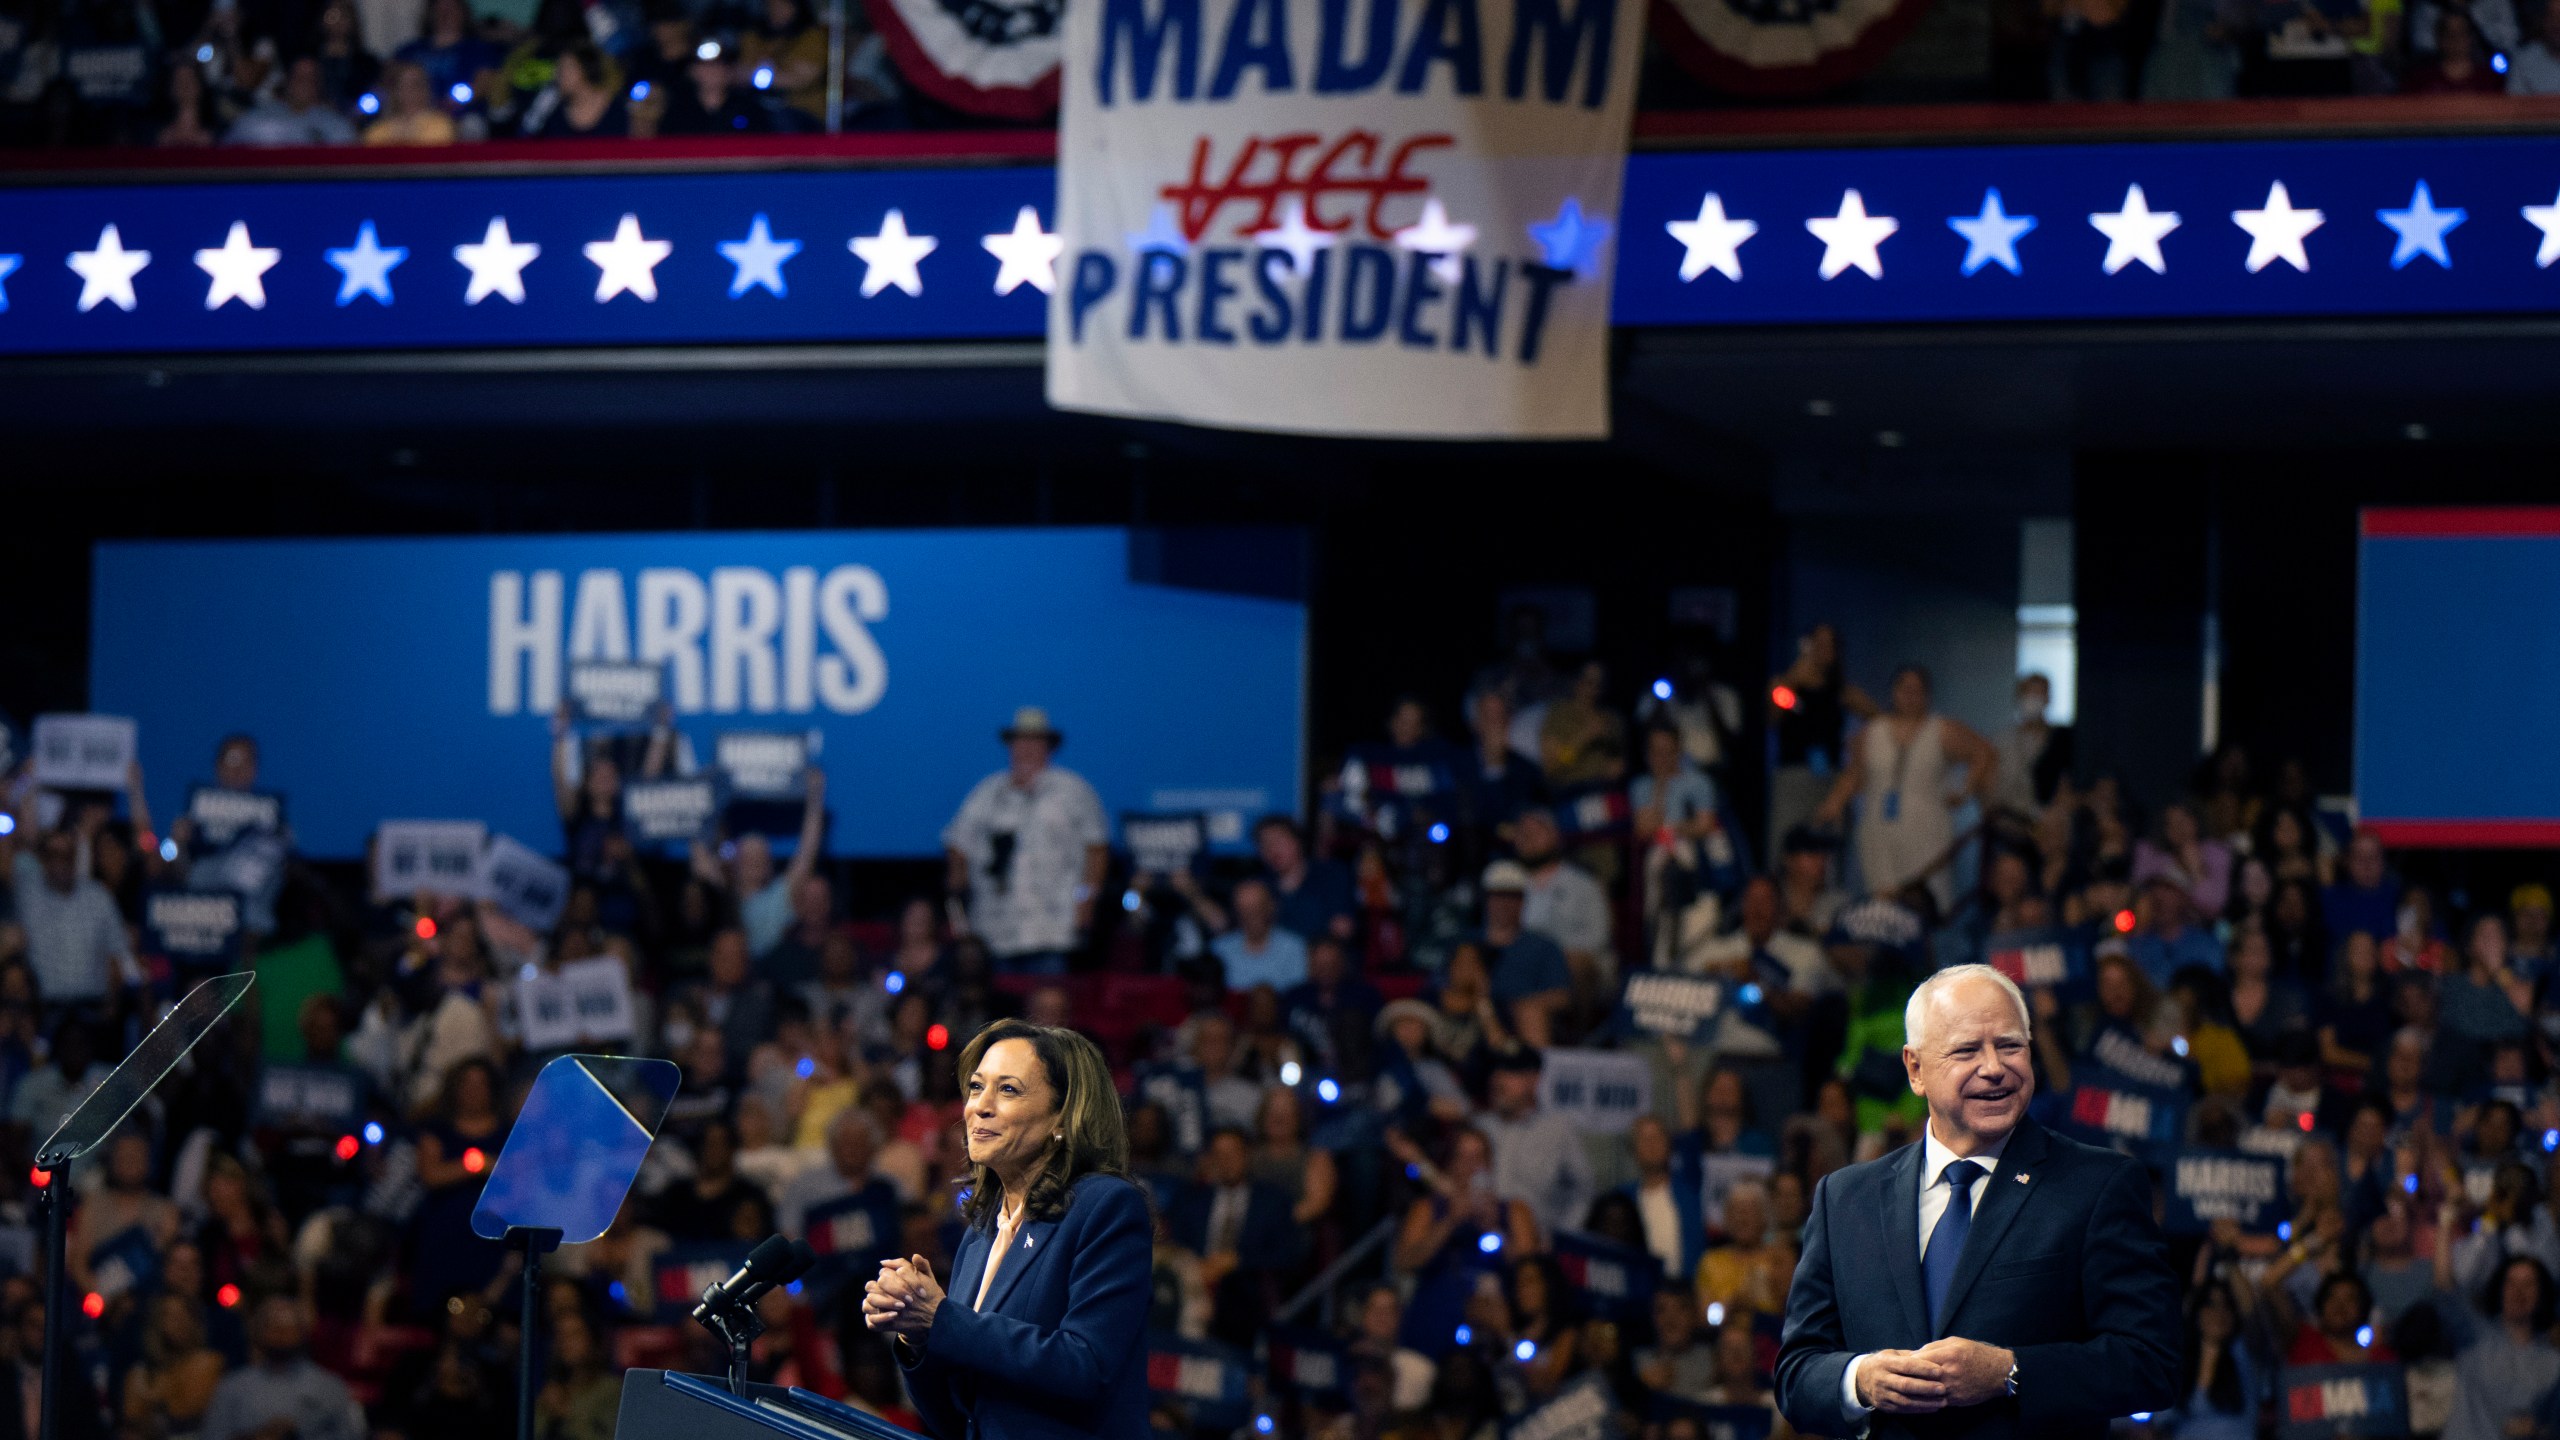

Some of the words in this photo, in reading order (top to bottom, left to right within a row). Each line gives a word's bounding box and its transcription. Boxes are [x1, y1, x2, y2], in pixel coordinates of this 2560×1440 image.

[1095, 0, 1614, 109] MADAM
[1163, 130, 1455, 243] VICE
[1067, 242, 1575, 367] PRESIDENT
[488, 563, 889, 716] HARRIS
[2176, 1158, 2277, 1200] HARRIS
